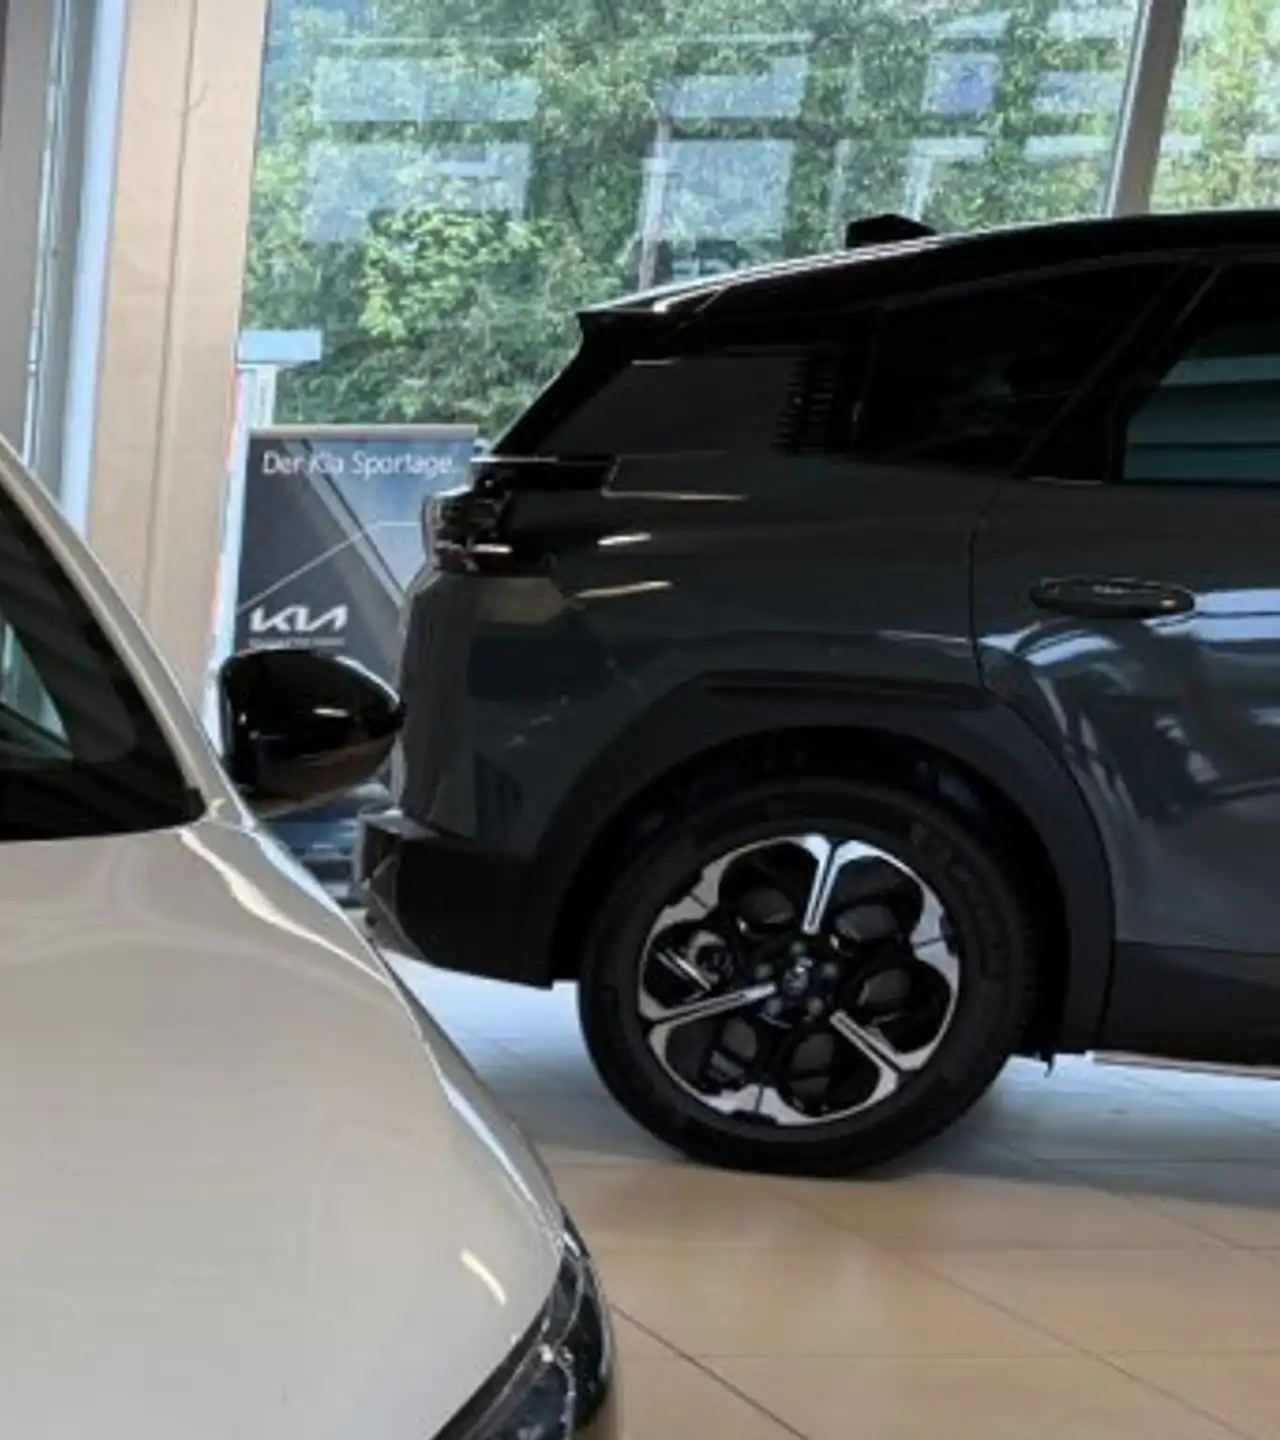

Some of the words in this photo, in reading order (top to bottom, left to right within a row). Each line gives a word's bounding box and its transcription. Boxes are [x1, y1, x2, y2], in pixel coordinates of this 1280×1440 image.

[262, 450, 301, 475] Der
[308, 451, 344, 476] Kia
[249, 603, 349, 633] KIA
